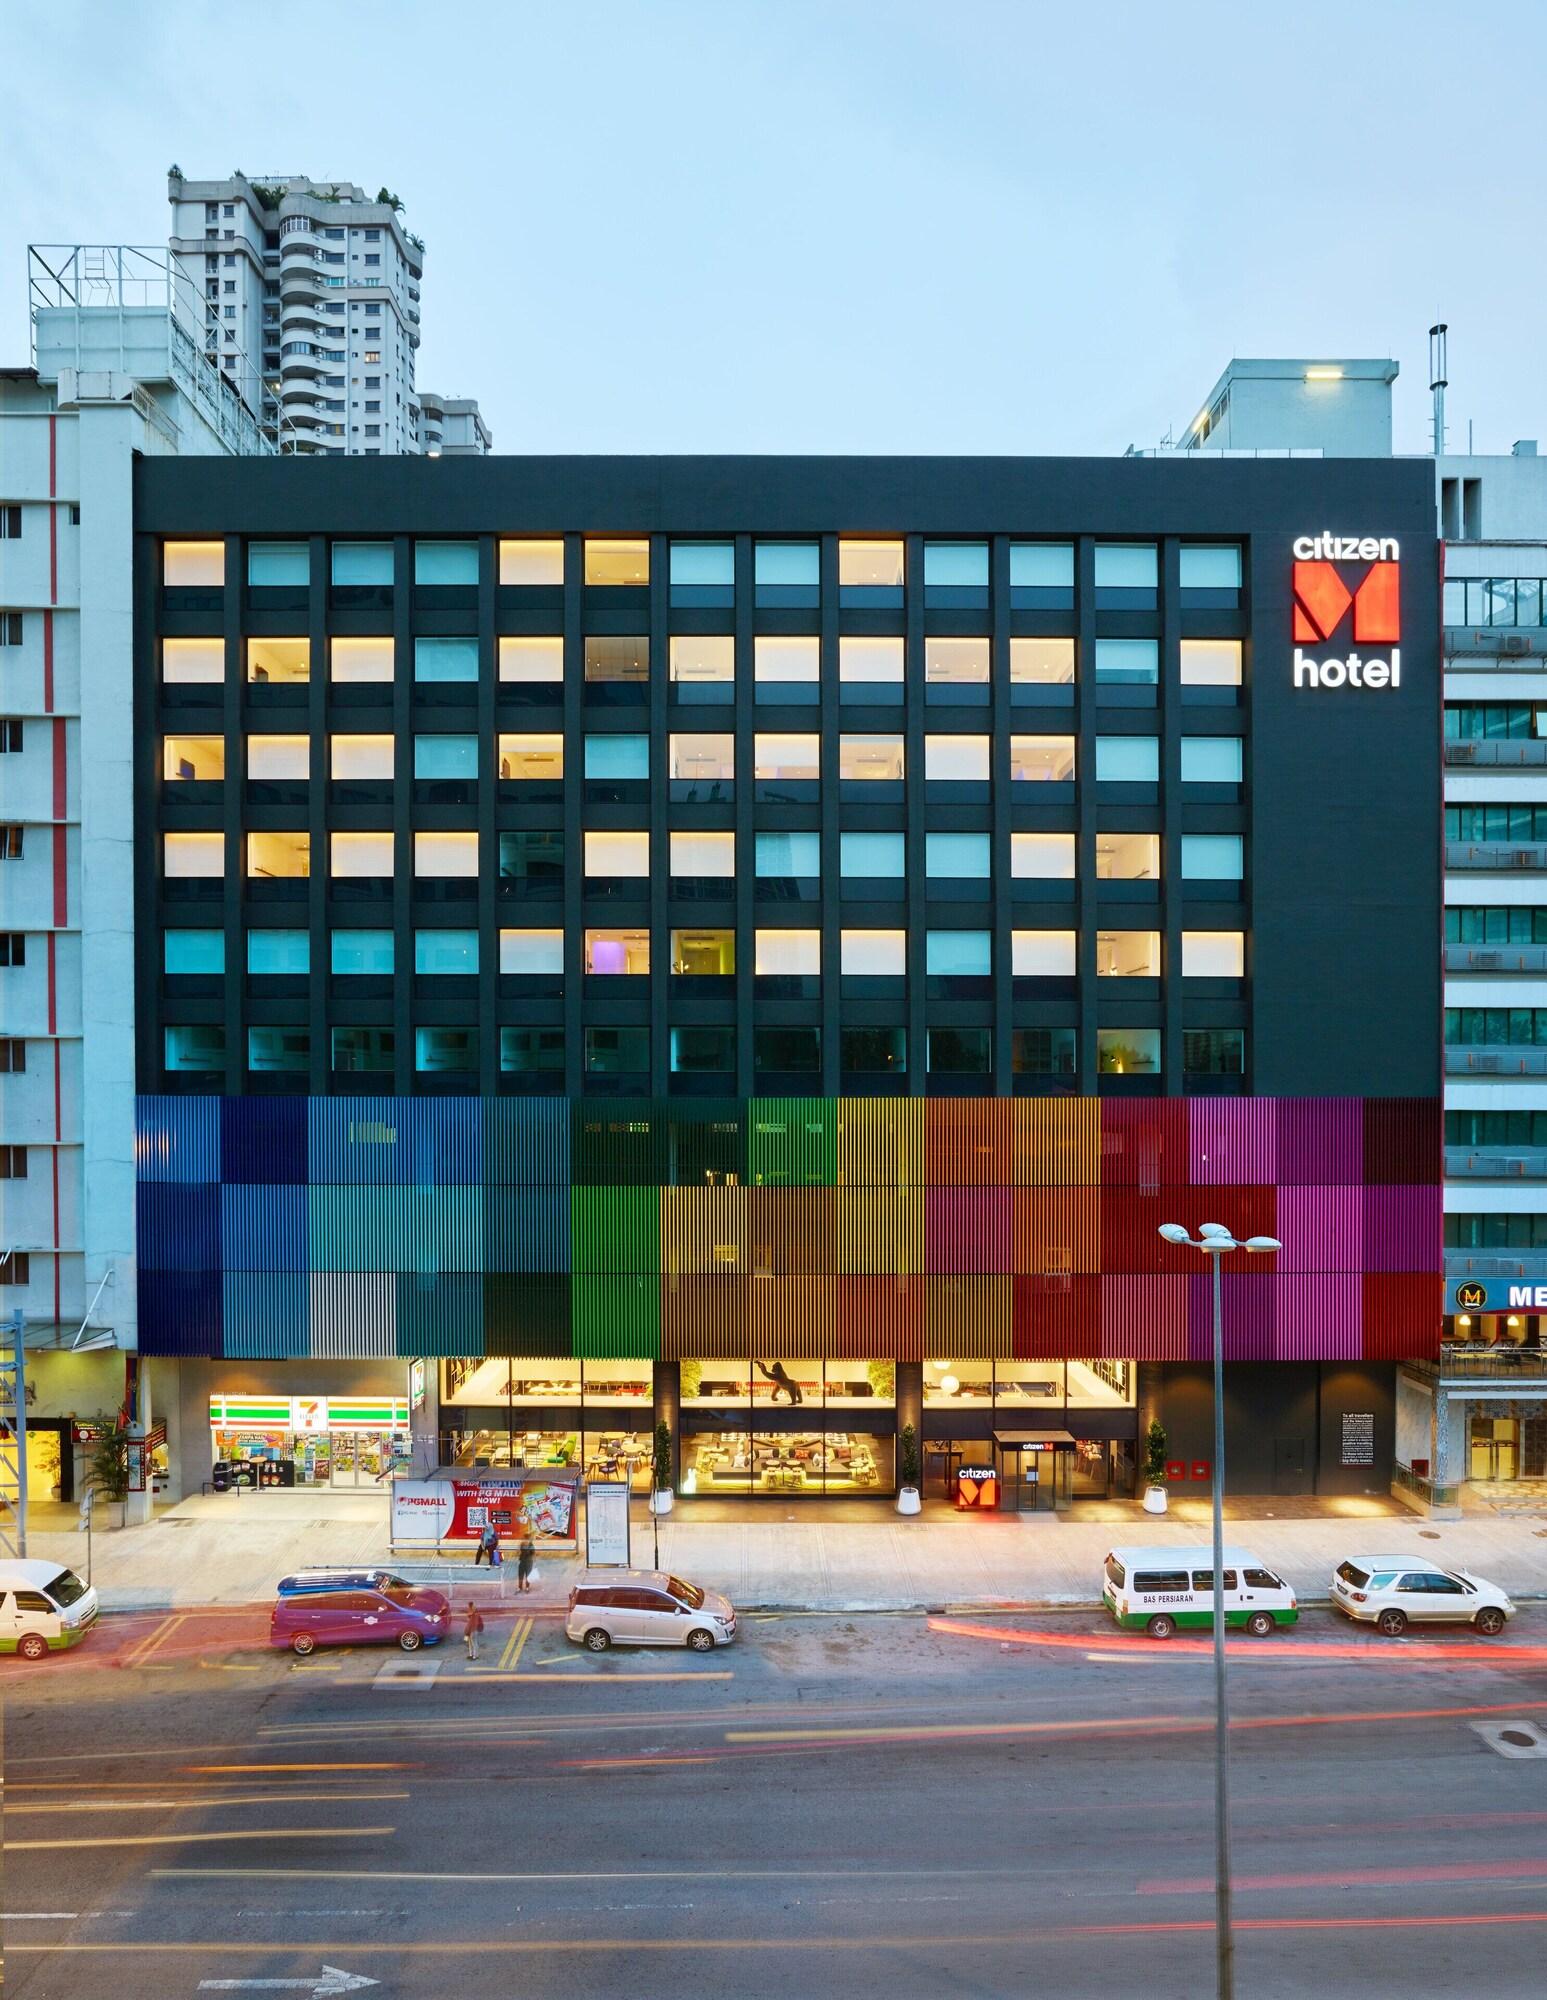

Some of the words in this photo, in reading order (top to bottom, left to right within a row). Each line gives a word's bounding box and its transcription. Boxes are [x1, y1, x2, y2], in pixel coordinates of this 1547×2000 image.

[1293, 531, 1399, 560] citizen
[1292, 561, 1400, 644] M
[1293, 648, 1400, 688] hotel
[1509, 1286, 1547, 1307] ME
[959, 1467, 996, 1479] citizen
[408, 1497, 447, 1506] PGMALL
[478, 1489, 492, 1497] PG
[494, 1489, 520, 1498] MALL
[959, 1479, 996, 1506] M
[1143, 1595, 1156, 1603] BAS
[1158, 1594, 1194, 1603] PERSIARAN
